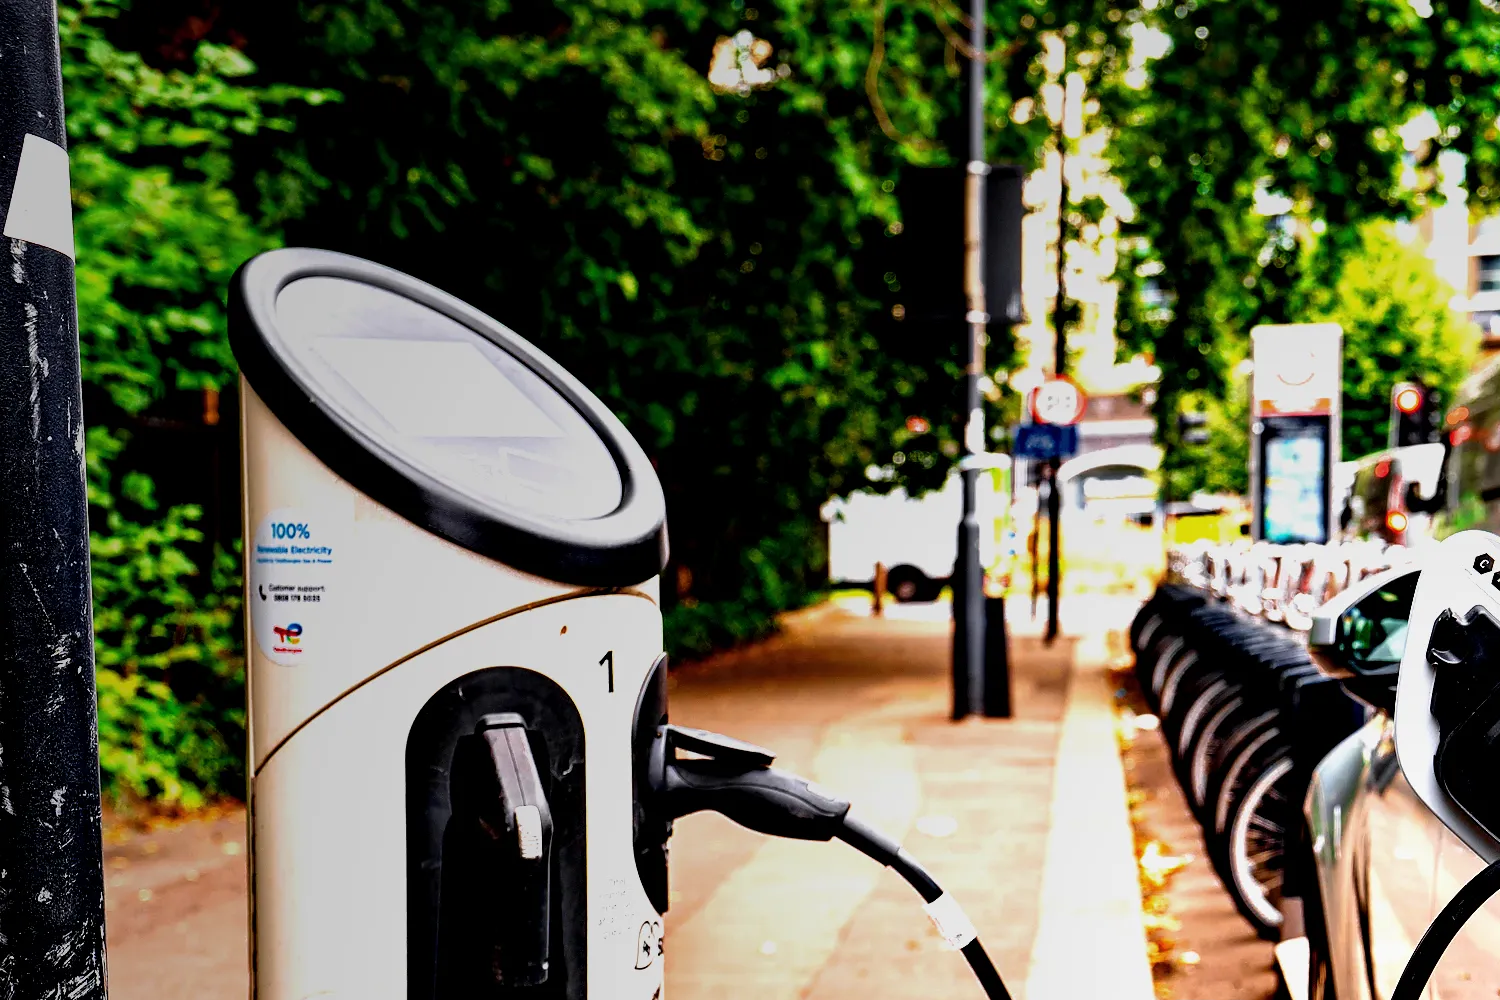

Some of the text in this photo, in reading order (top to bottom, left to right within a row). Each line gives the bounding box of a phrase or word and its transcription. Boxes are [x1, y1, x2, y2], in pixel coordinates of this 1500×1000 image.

[271, 523, 310, 539] 100%
[291, 545, 332, 555] Electricity
[599, 650, 614, 693] 1
